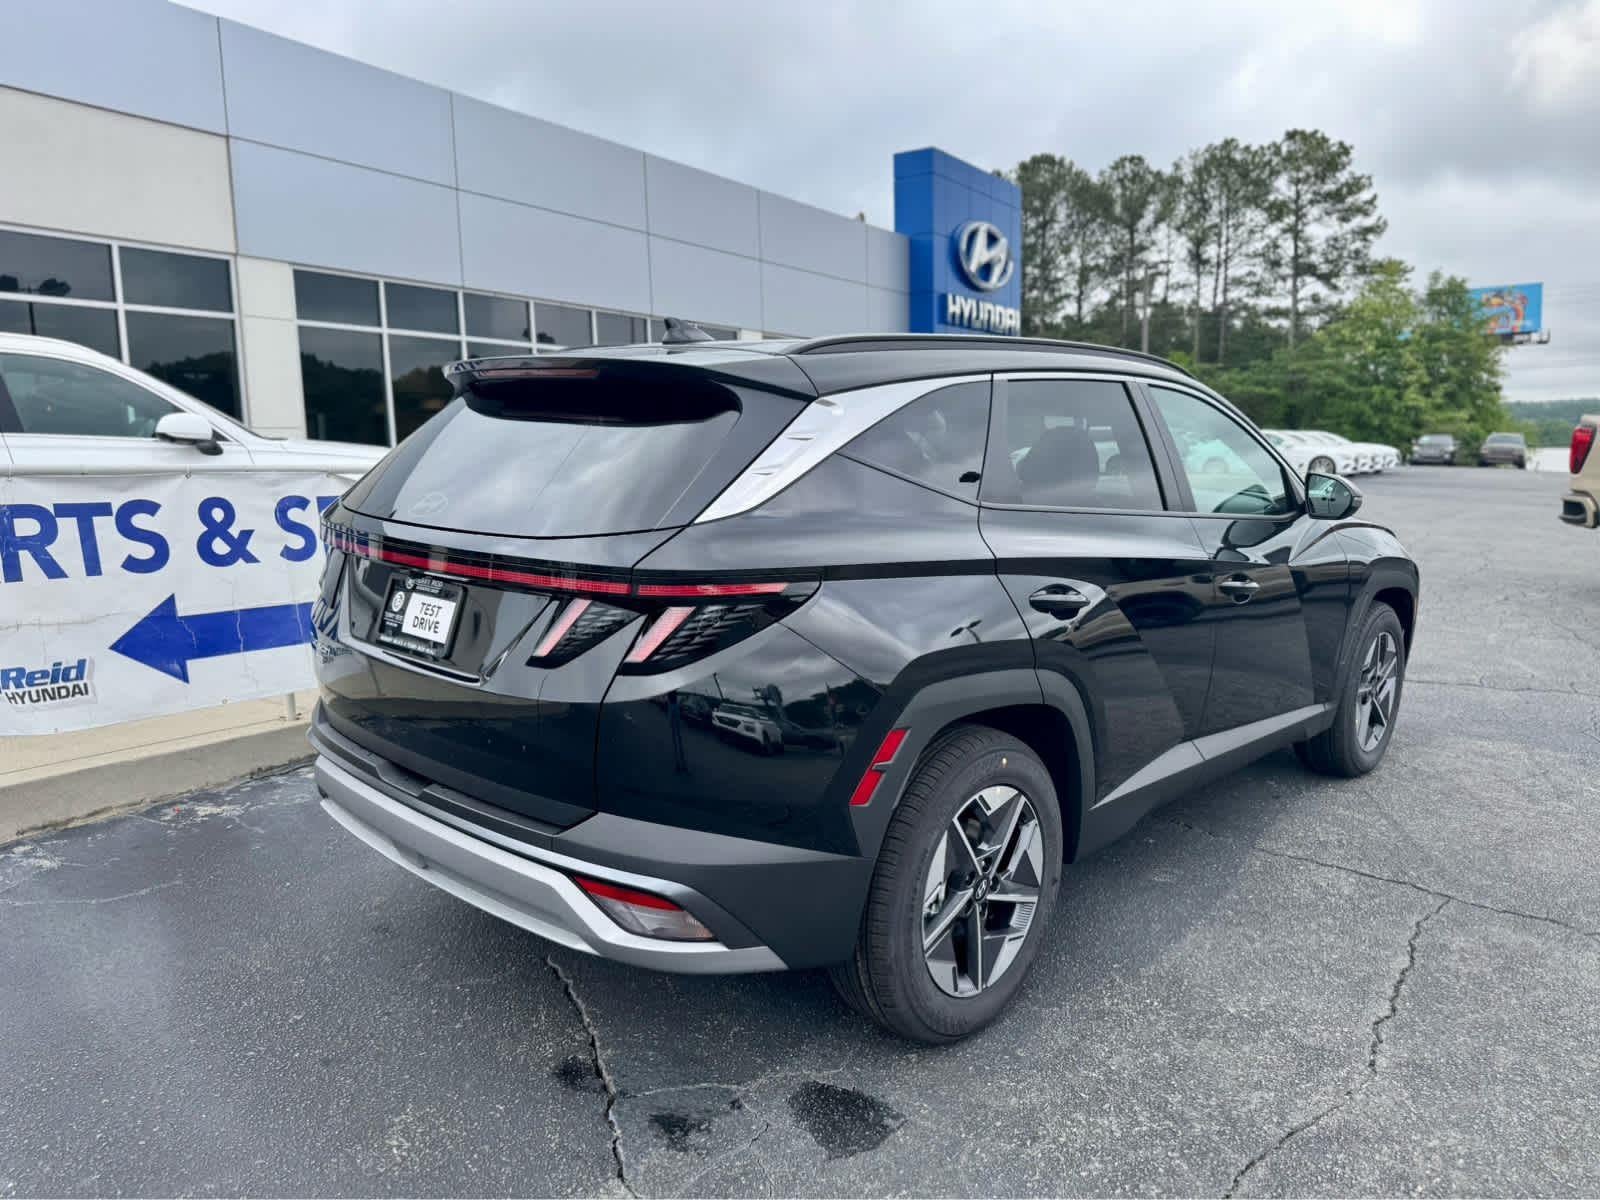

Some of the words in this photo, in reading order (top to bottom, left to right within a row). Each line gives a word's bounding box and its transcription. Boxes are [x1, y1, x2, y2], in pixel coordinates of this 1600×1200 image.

[947, 293, 1021, 336] HYUNDAI
[196, 496, 261, 567] &
[275, 495, 340, 562] S
[421, 602, 443, 618] TEST
[412, 616, 440, 634] DRIVE
[0, 659, 87, 690] Reid
[4, 682, 89, 704] HYUNDAI
